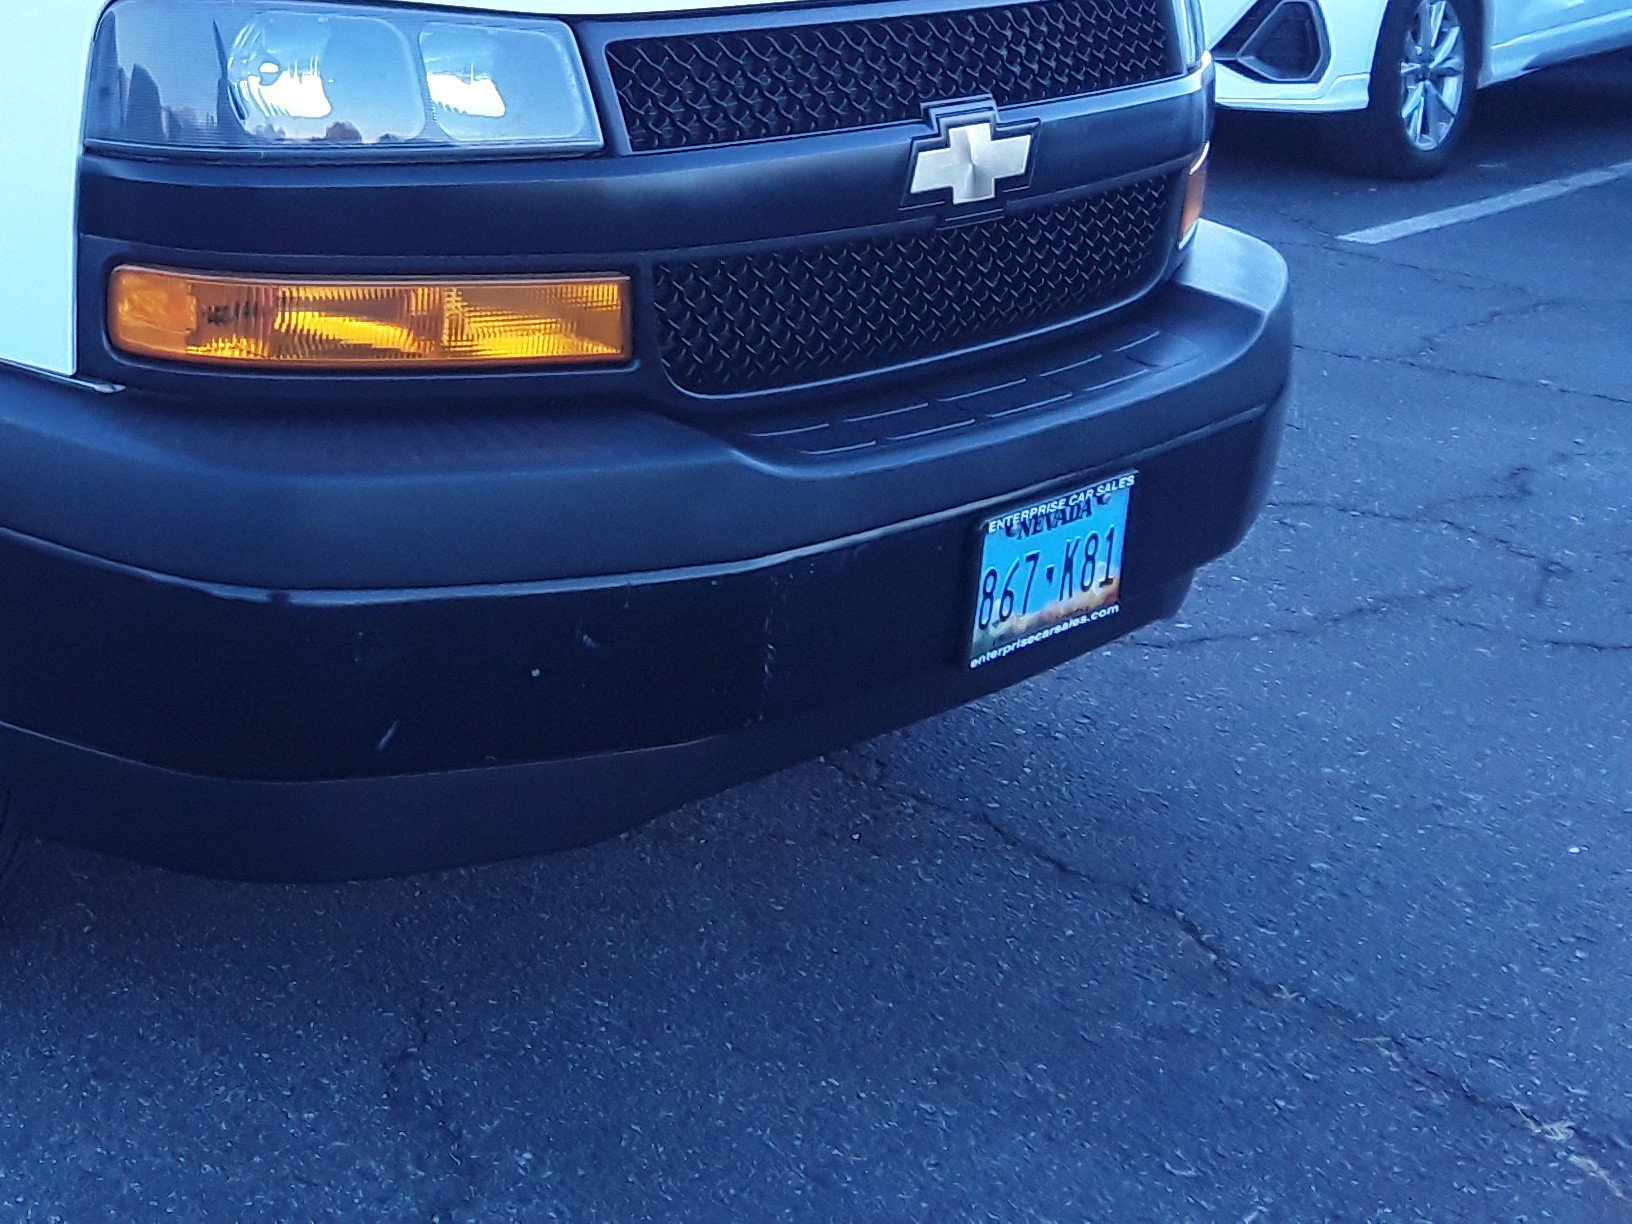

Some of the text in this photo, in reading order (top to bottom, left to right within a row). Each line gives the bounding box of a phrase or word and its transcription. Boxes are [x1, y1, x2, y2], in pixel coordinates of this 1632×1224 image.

[988, 475, 1135, 533] ENTERPRISE CAR SALES
[1015, 498, 1092, 540] NEVADA
[970, 604, 1120, 669] enterprisecarsales.com
